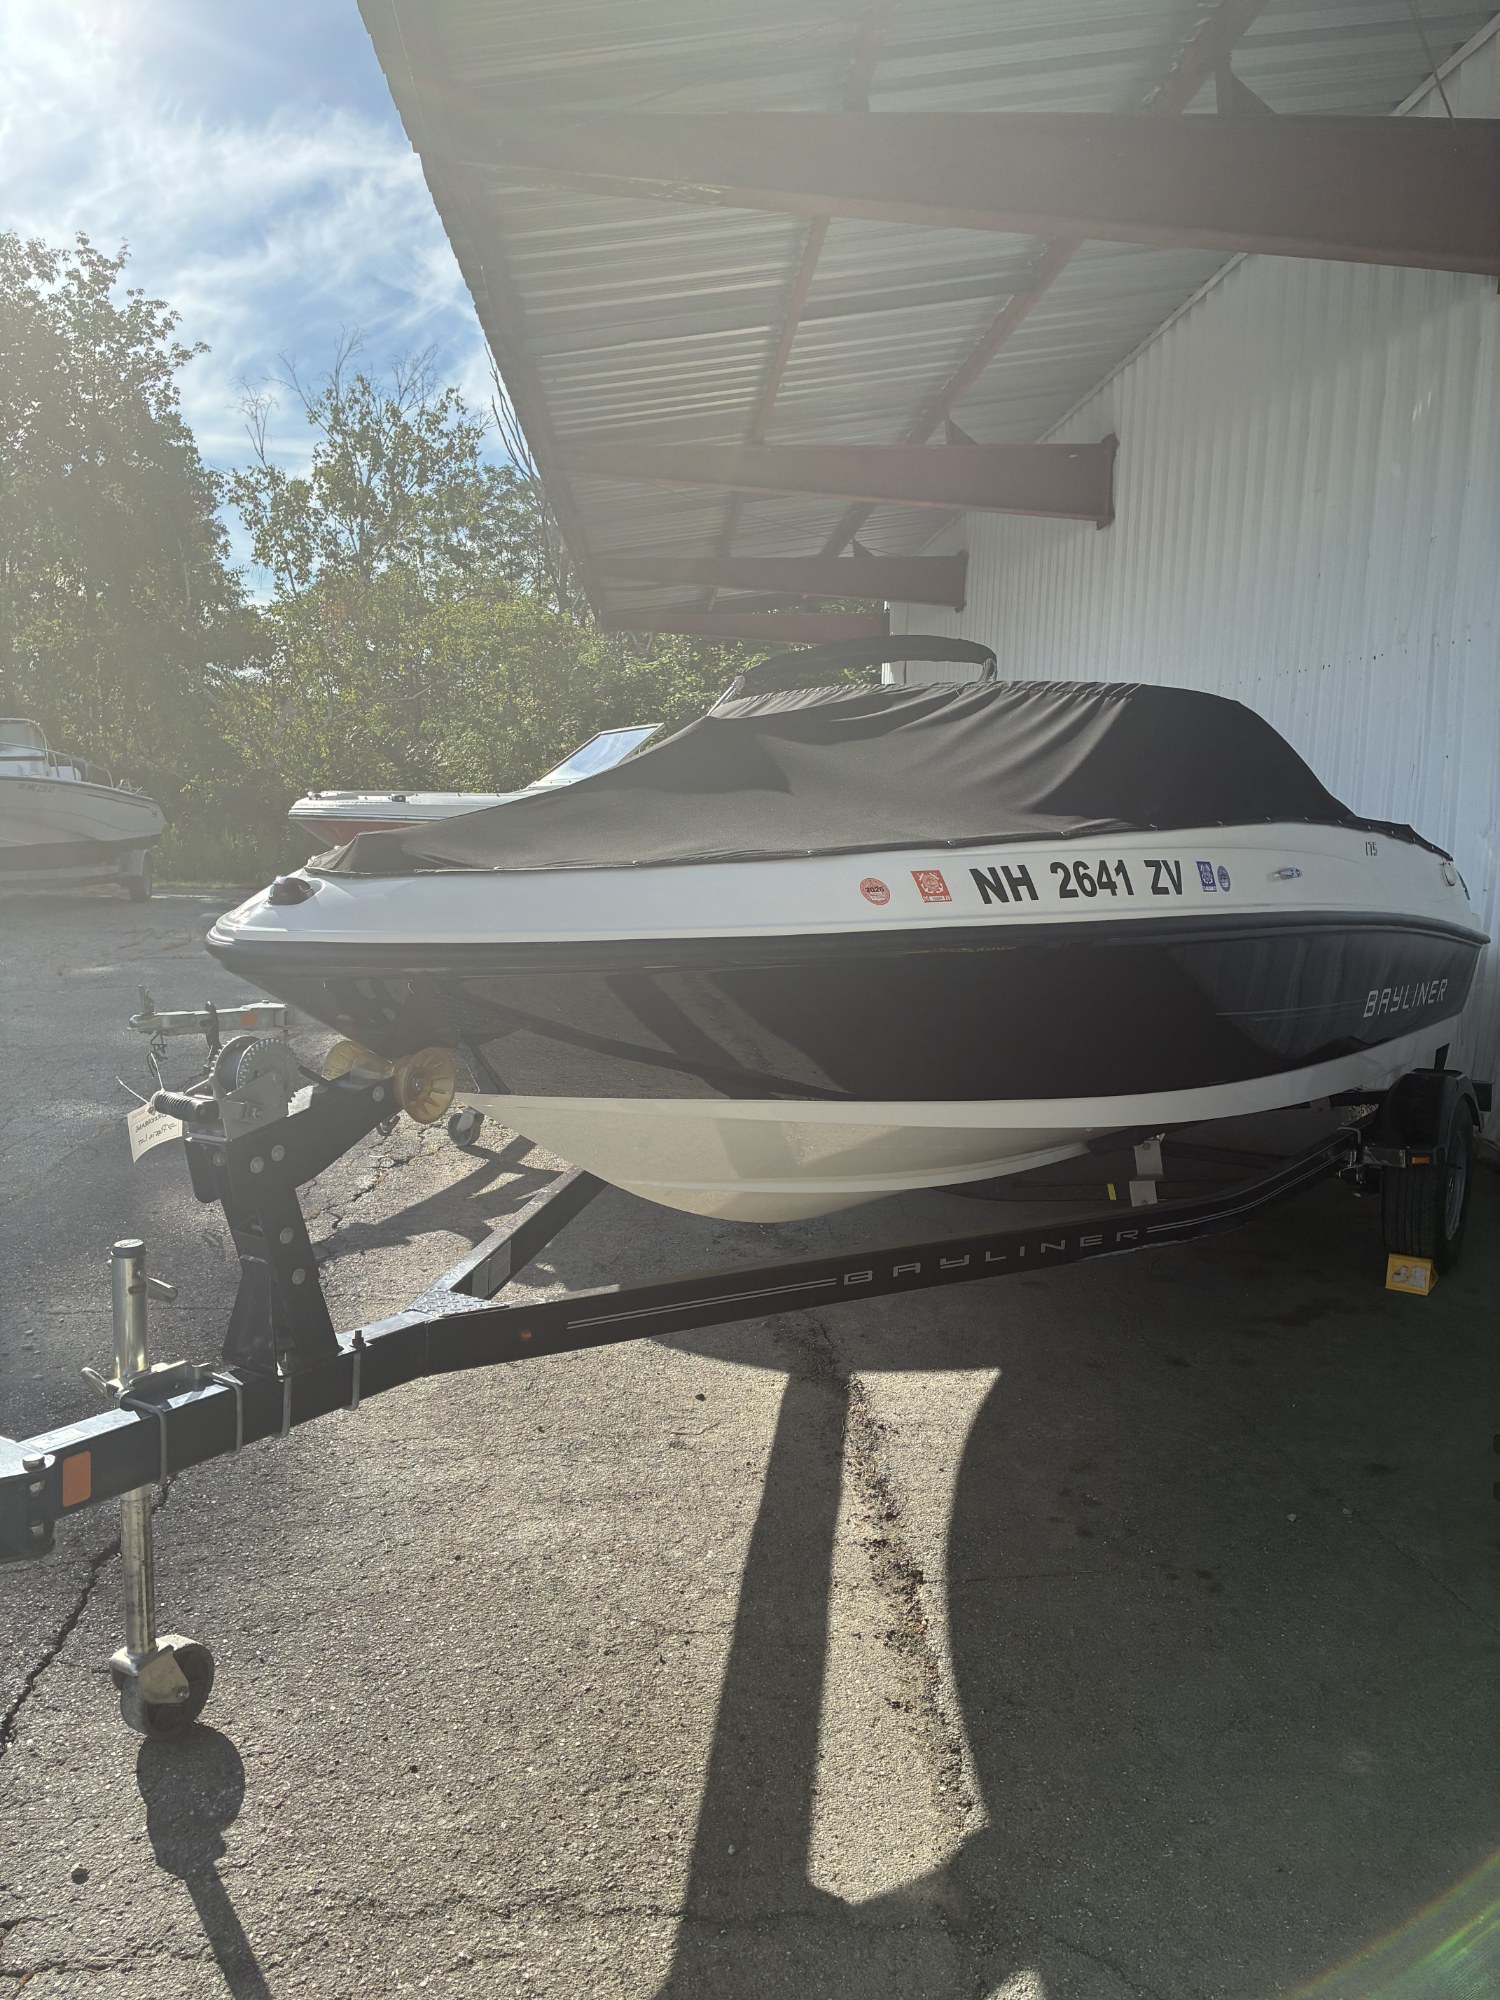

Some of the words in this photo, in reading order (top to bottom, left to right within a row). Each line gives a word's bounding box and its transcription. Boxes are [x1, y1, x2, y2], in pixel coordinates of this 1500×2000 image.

[969, 864, 1038, 905] NH
[1050, 859, 1134, 899] 2641
[1144, 860, 1183, 895] ZV
[1363, 978, 1449, 1018] BAYLINER
[843, 1228, 1142, 1286] BAYLINER
